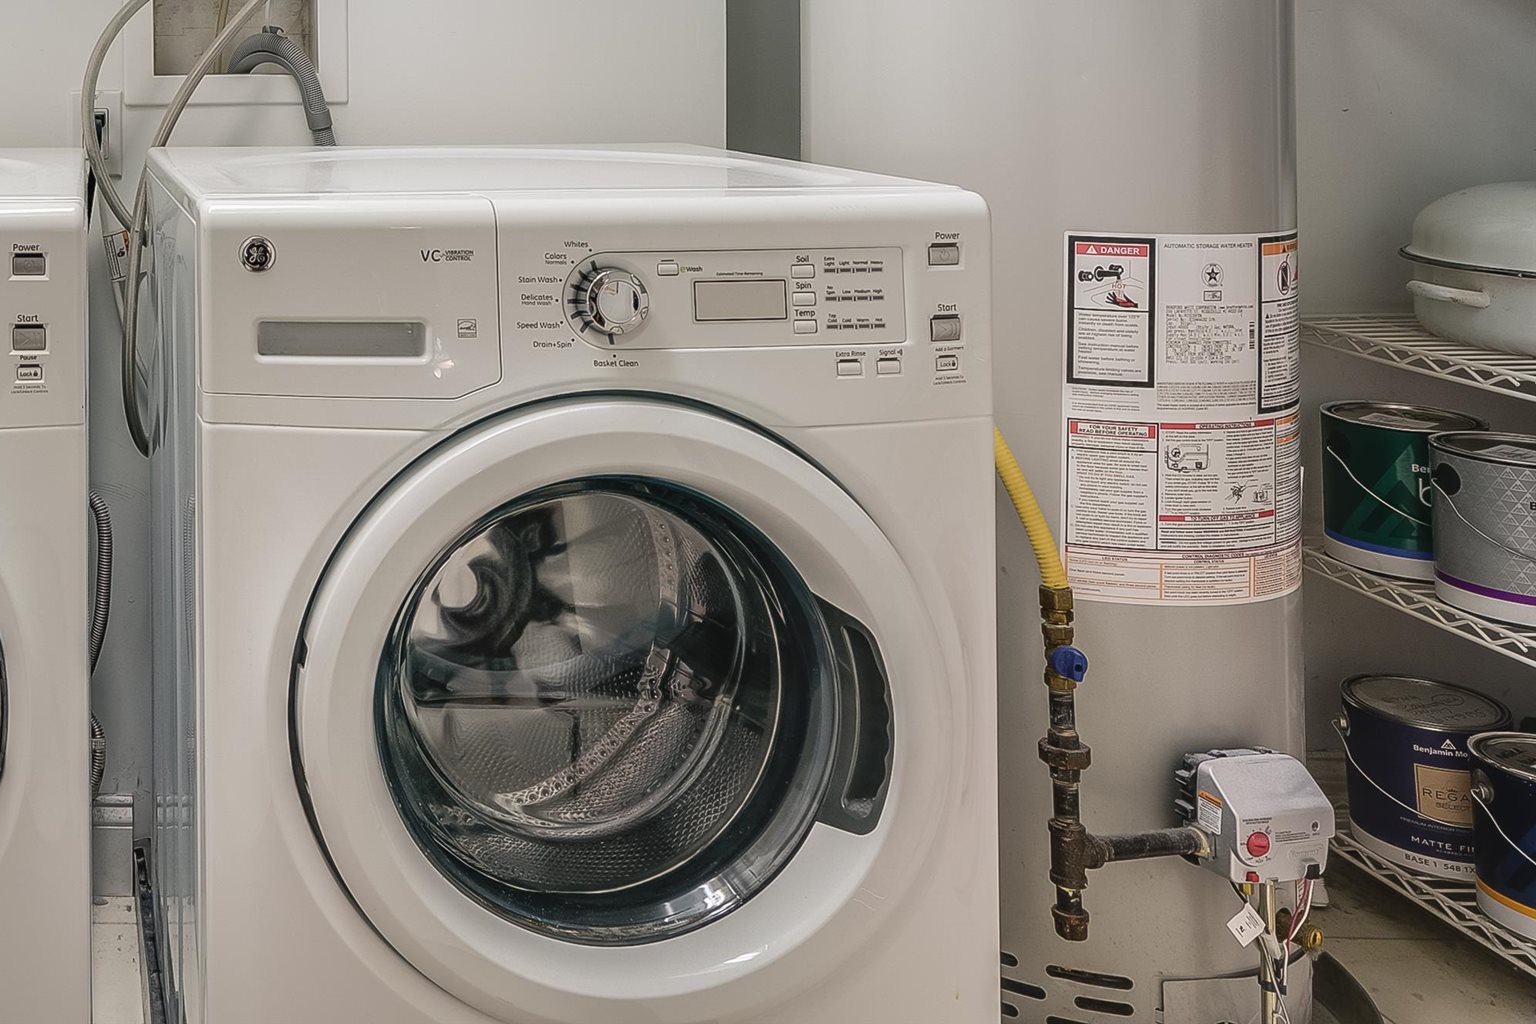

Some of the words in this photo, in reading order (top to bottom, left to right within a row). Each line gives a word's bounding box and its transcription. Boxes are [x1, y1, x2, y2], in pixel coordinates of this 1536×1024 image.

[935, 232, 960, 240] Power
[12, 243, 40, 251] Power
[1100, 246, 1140, 255] DANGER
[420, 249, 441, 262] VC
[544, 252, 567, 260] Colors
[796, 255, 809, 263] Soil
[796, 282, 812, 290] Spin
[937, 303, 957, 312] Start
[795, 309, 815, 317] Temp
[17, 314, 39, 323] Start
[517, 322, 538, 330] Speed
[1413, 744, 1453, 757] Benjamin
[1411, 835, 1453, 850] MATTE
[1405, 853, 1430, 866] BASE
